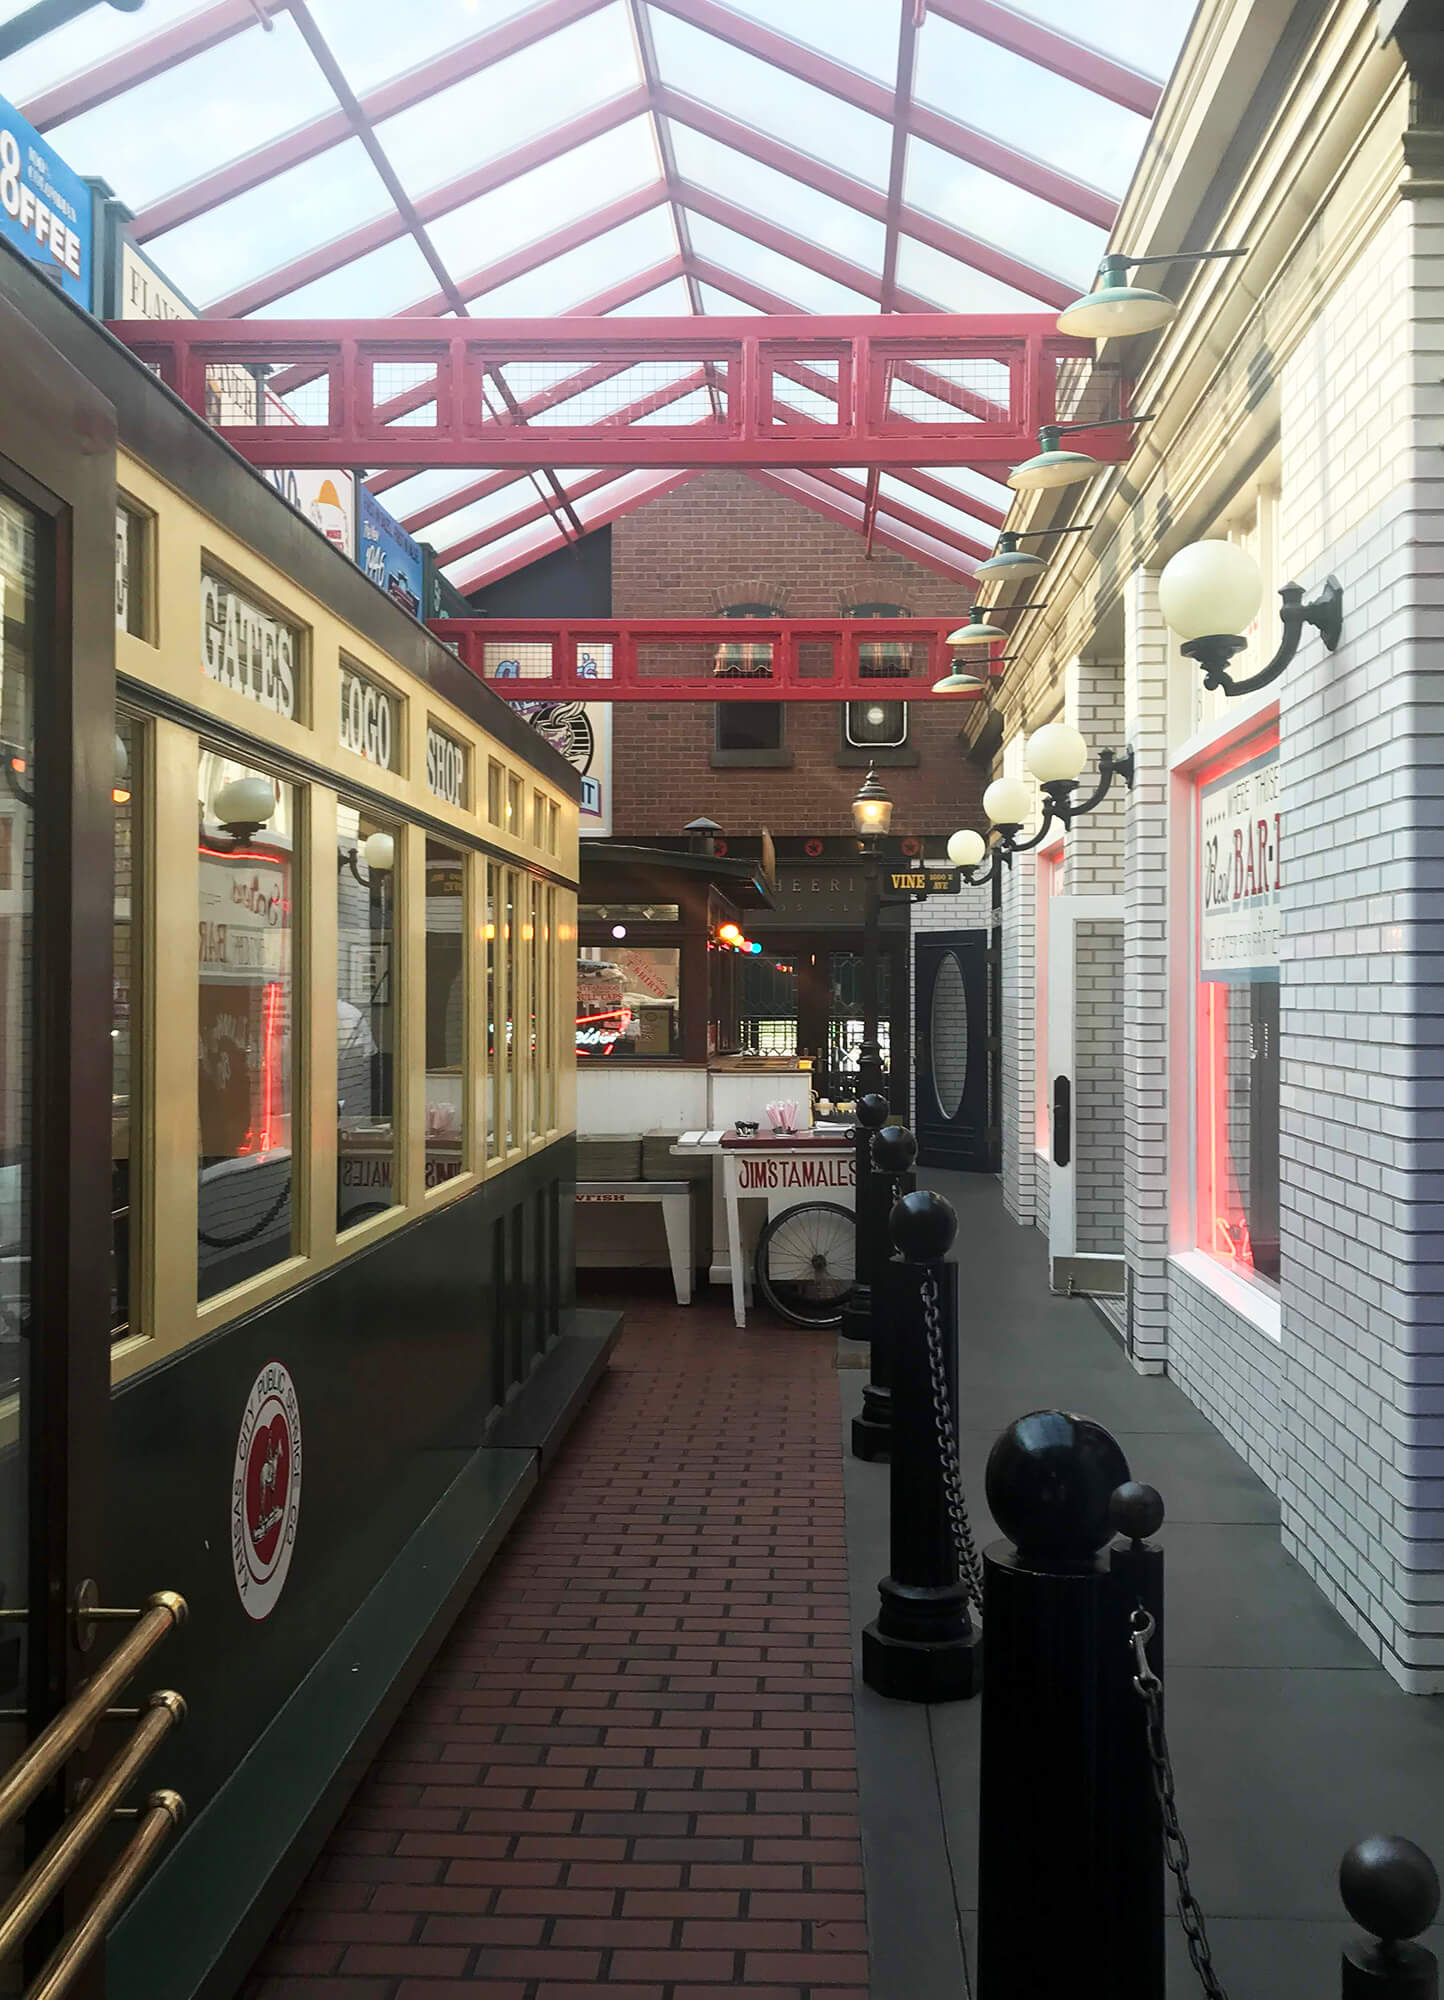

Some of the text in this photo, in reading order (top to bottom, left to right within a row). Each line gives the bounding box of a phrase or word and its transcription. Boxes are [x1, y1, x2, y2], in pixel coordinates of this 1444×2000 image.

[201, 574, 464, 808] GATES LOGO SHOP
[891, 874, 926, 889] VINE
[779, 1159, 857, 1188] TAMALES
[257, 1366, 286, 1402] PUBLIC
[239, 1398, 255, 1461] CITY
[233, 1478, 250, 1597] KANSAS
